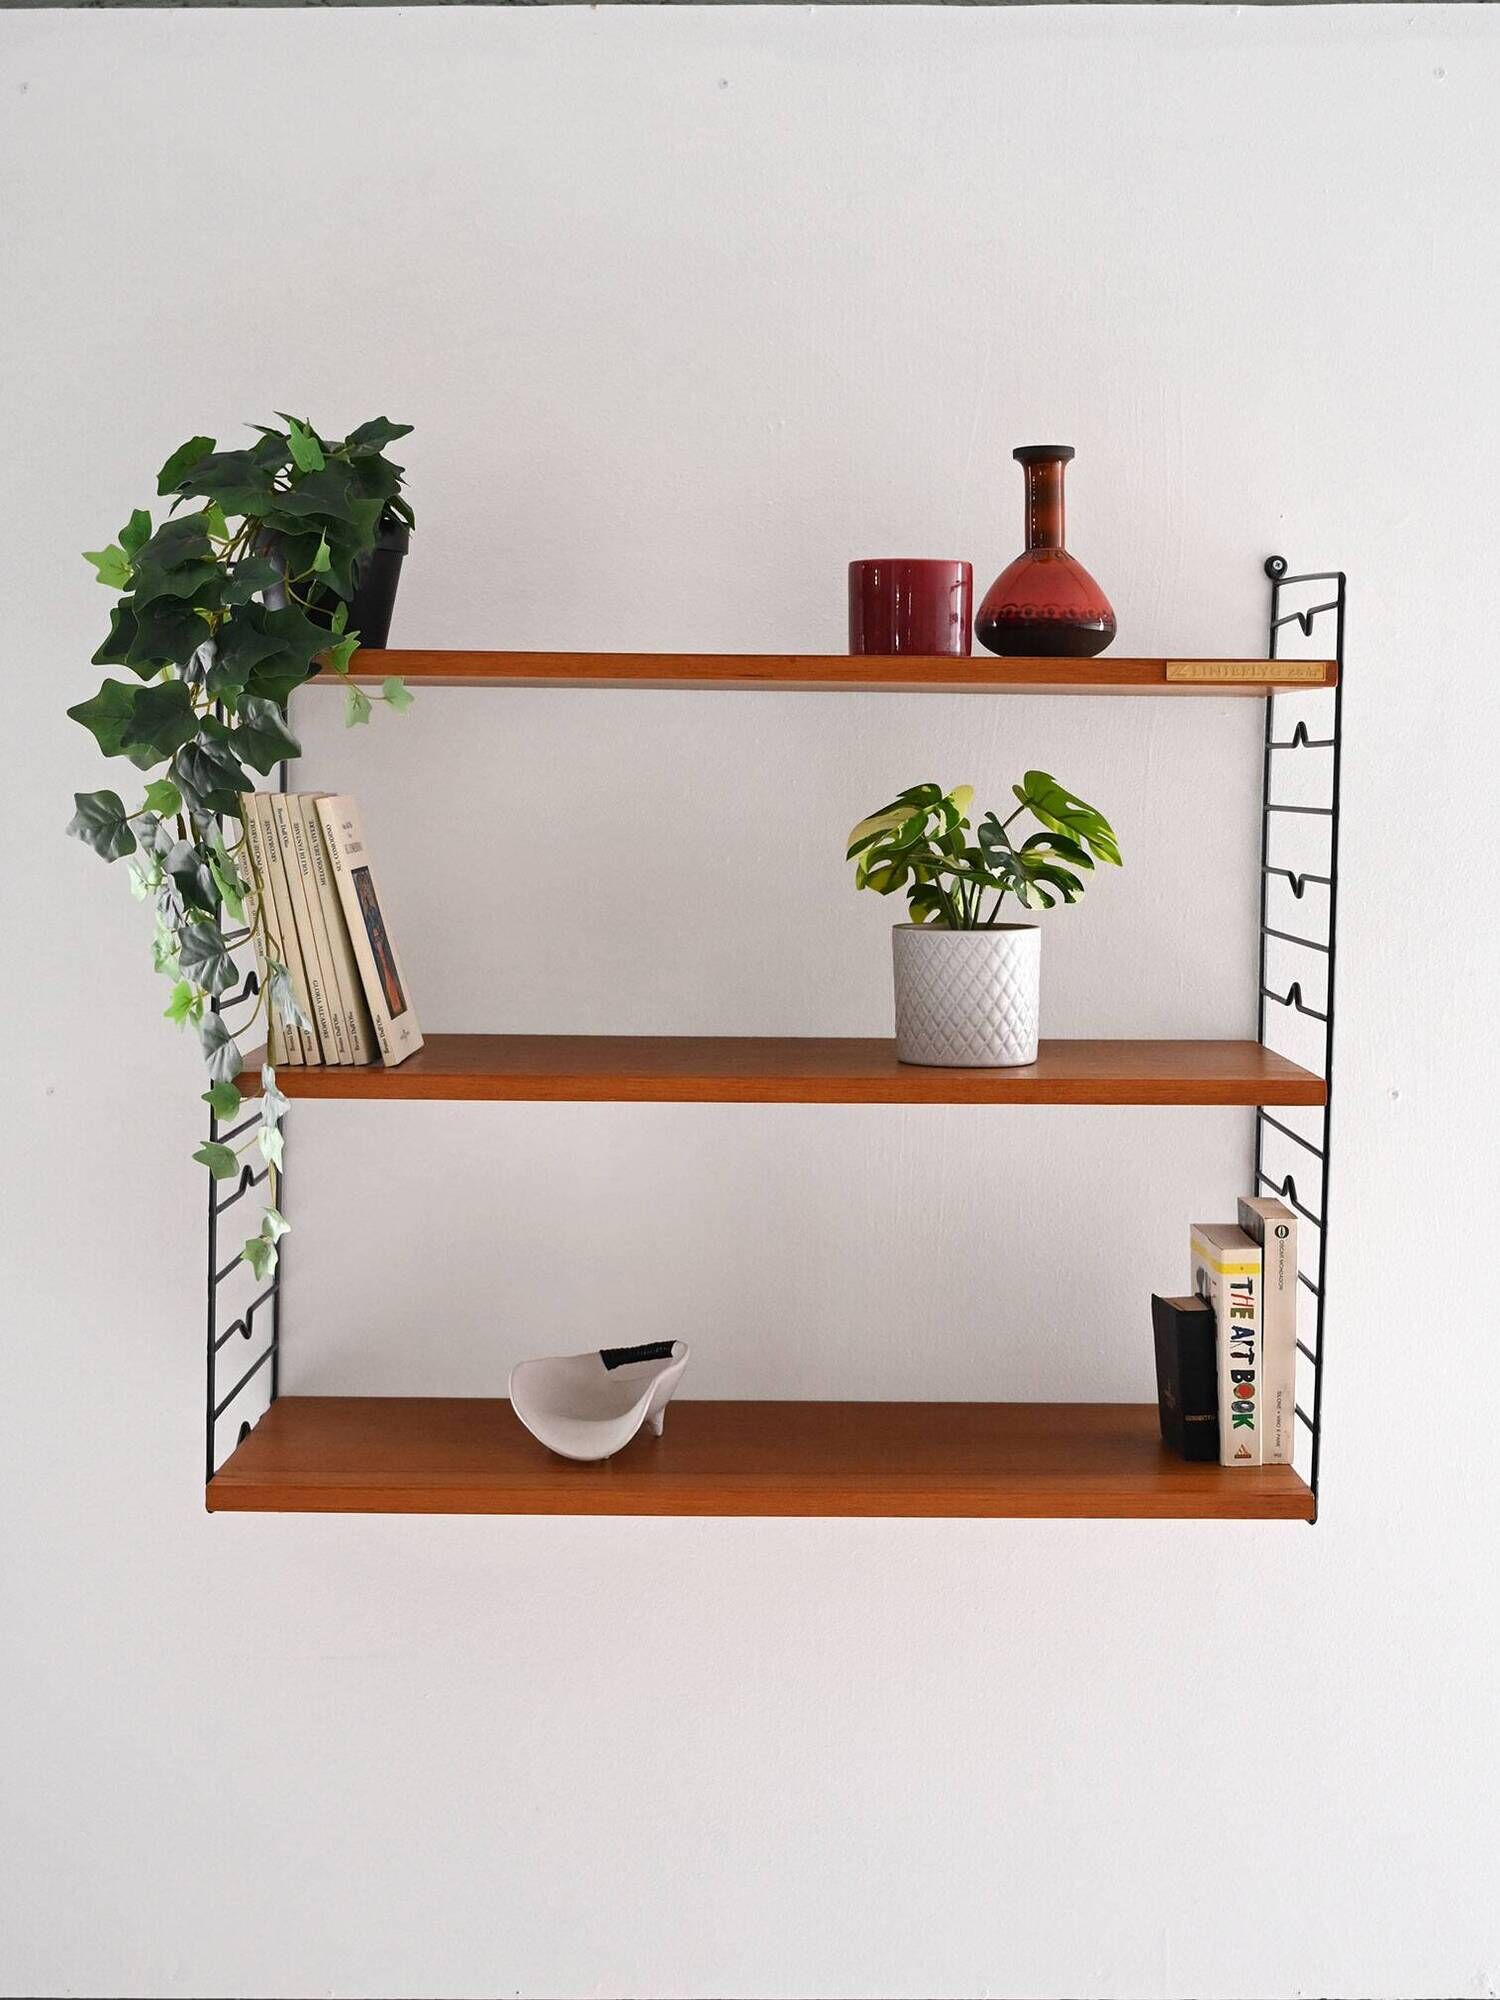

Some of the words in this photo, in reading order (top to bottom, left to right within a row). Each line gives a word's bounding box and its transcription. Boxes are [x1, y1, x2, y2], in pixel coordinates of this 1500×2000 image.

[249, 820, 258, 842] PAROLE
[308, 820, 318, 844] VIVERE
[312, 980, 322, 1003] GLORIA
[1230, 1276, 1254, 1319] THE
[1230, 1325, 1255, 1365] ART
[1230, 1369, 1255, 1430] BOOK
